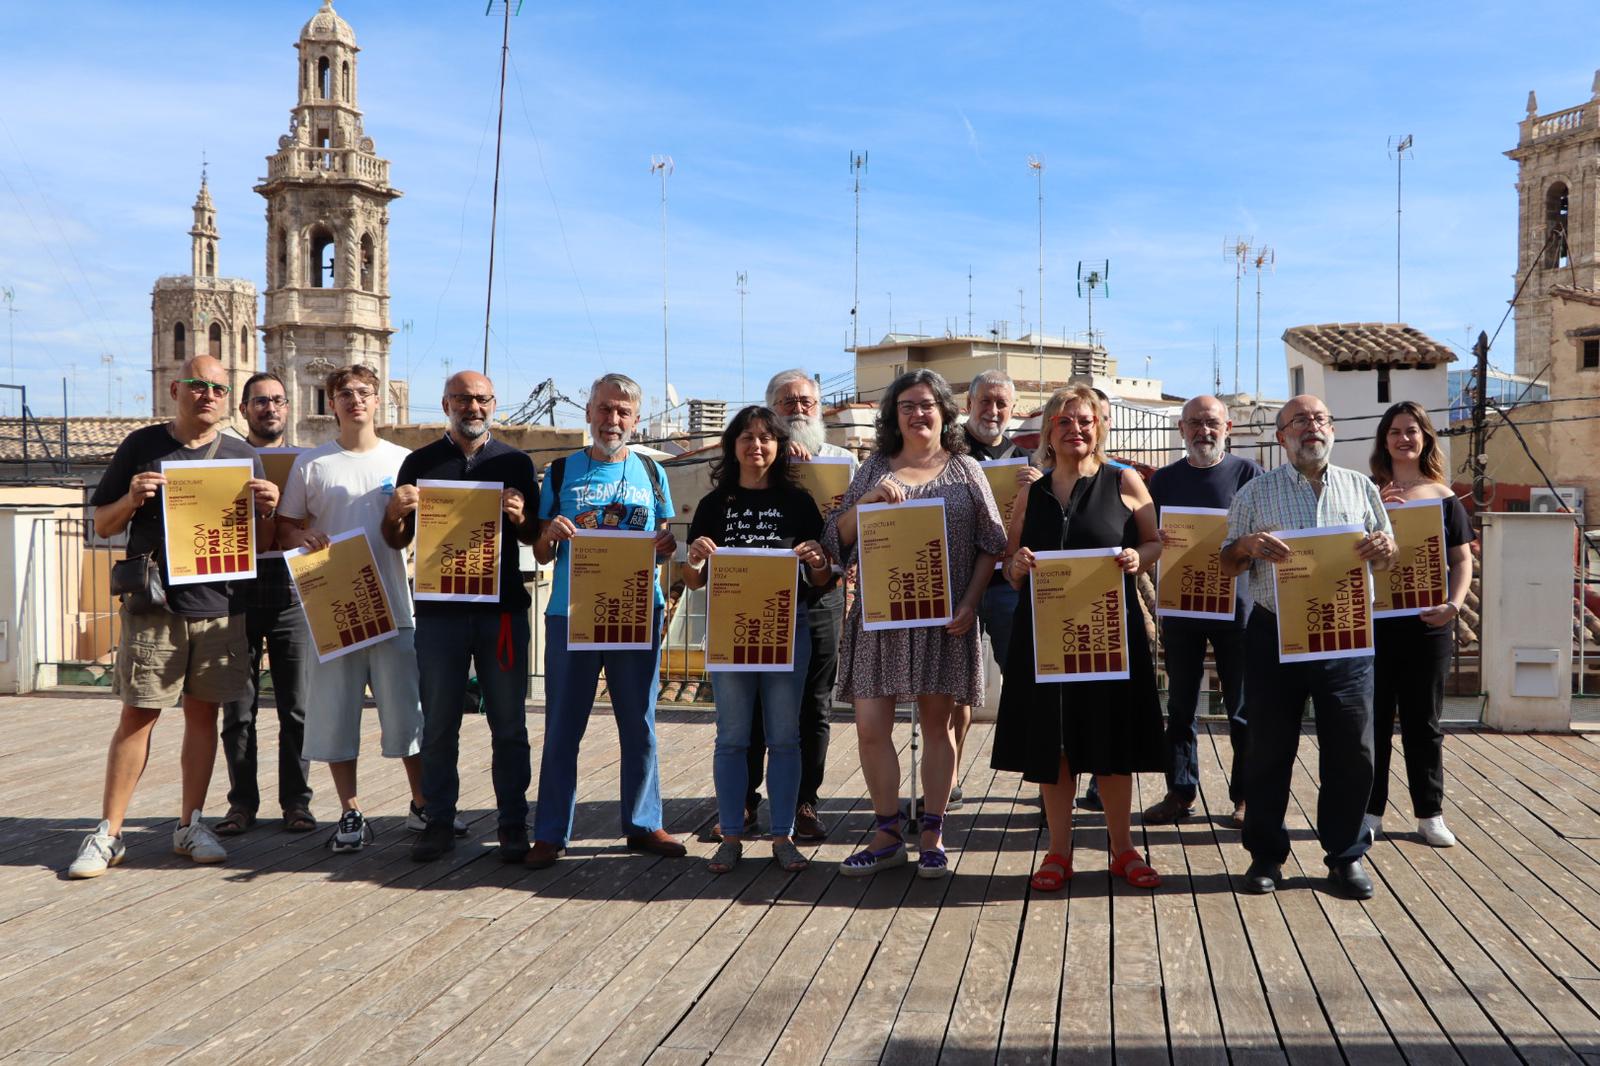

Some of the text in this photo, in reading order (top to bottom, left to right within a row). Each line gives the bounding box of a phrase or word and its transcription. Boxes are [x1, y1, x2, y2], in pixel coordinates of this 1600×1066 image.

[194, 524, 206, 555] SOM
[222, 508, 234, 553] PARLEM
[232, 498, 248, 552] VALENCIÀ
[441, 544, 453, 574] SOM
[469, 530, 481, 575] PARLEM
[481, 521, 495, 576] VALENCIÀ
[926, 539, 944, 598] VALENCIÀ
[1416, 545, 1427, 589] PARLEM
[1424, 536, 1442, 588] VALENCIÀ
[358, 564, 386, 618] VALENCIÀ
[889, 567, 901, 600] SOM
[916, 550, 930, 598] PARLEM
[1182, 565, 1192, 593] SOM
[1207, 553, 1218, 594] PARLEM
[1390, 561, 1402, 591] SOM
[331, 600, 348, 630] SOM
[352, 578, 373, 622] PARLEM
[594, 592, 606, 624] SOM
[622, 578, 634, 624] PARLEM
[634, 570, 649, 624] VALENCIÀ
[776, 589, 790, 644] VALENCIÀ
[1307, 597, 1320, 631] SOM
[1337, 579, 1350, 629] PARLEM
[1346, 568, 1366, 629] VALENCIÀ
[734, 612, 746, 644] SOM
[762, 598, 776, 644] PARLEM
[1063, 618, 1076, 652] SOM
[1092, 601, 1106, 651] PARLEM
[1103, 590, 1120, 651] VALENCIÀ
